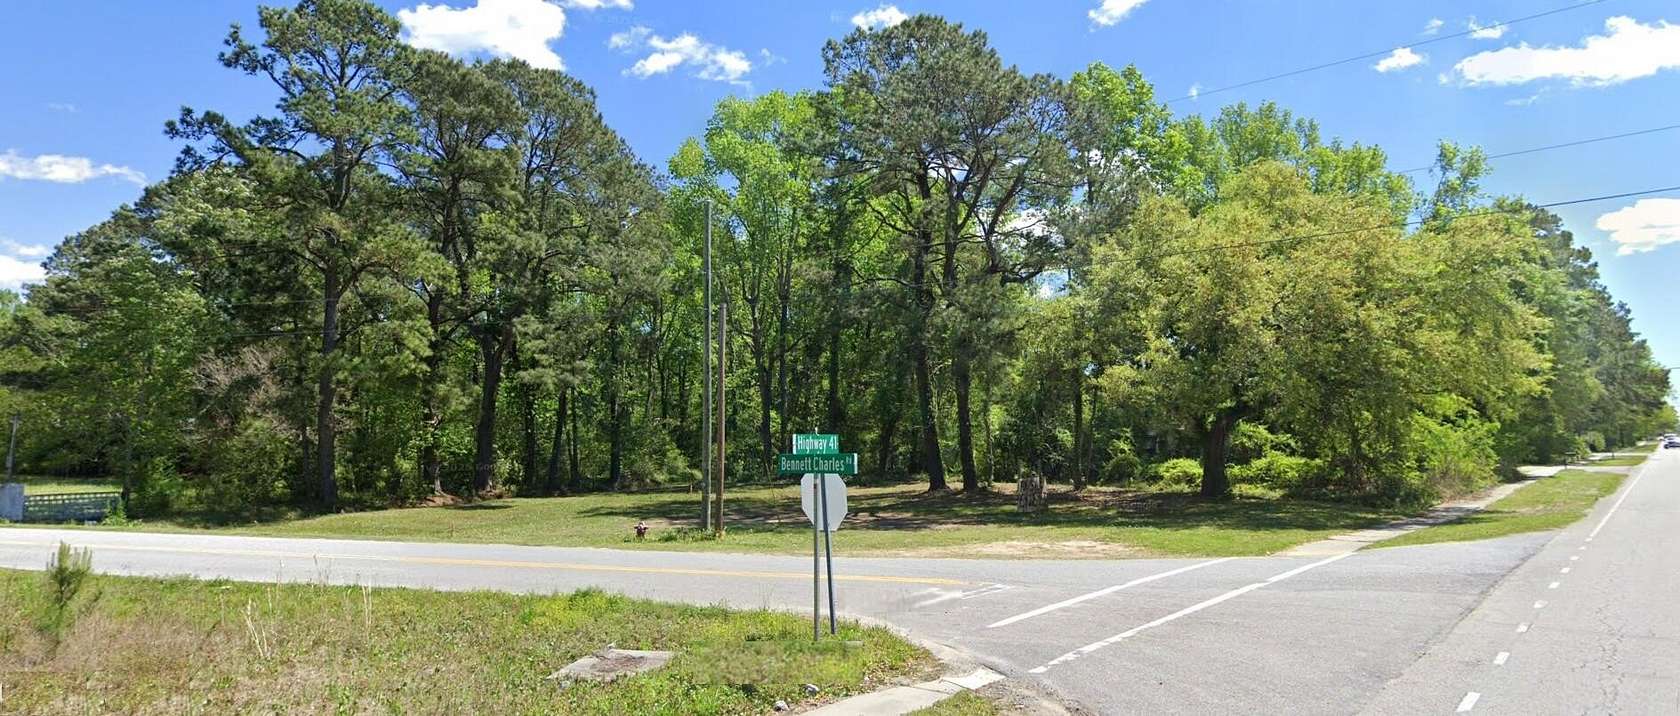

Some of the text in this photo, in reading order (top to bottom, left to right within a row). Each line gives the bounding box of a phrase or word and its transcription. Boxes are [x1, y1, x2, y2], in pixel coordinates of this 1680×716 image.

[798, 435, 838, 454] Highway 41
[781, 457, 812, 471] Bennett
[813, 457, 845, 471] Charles
